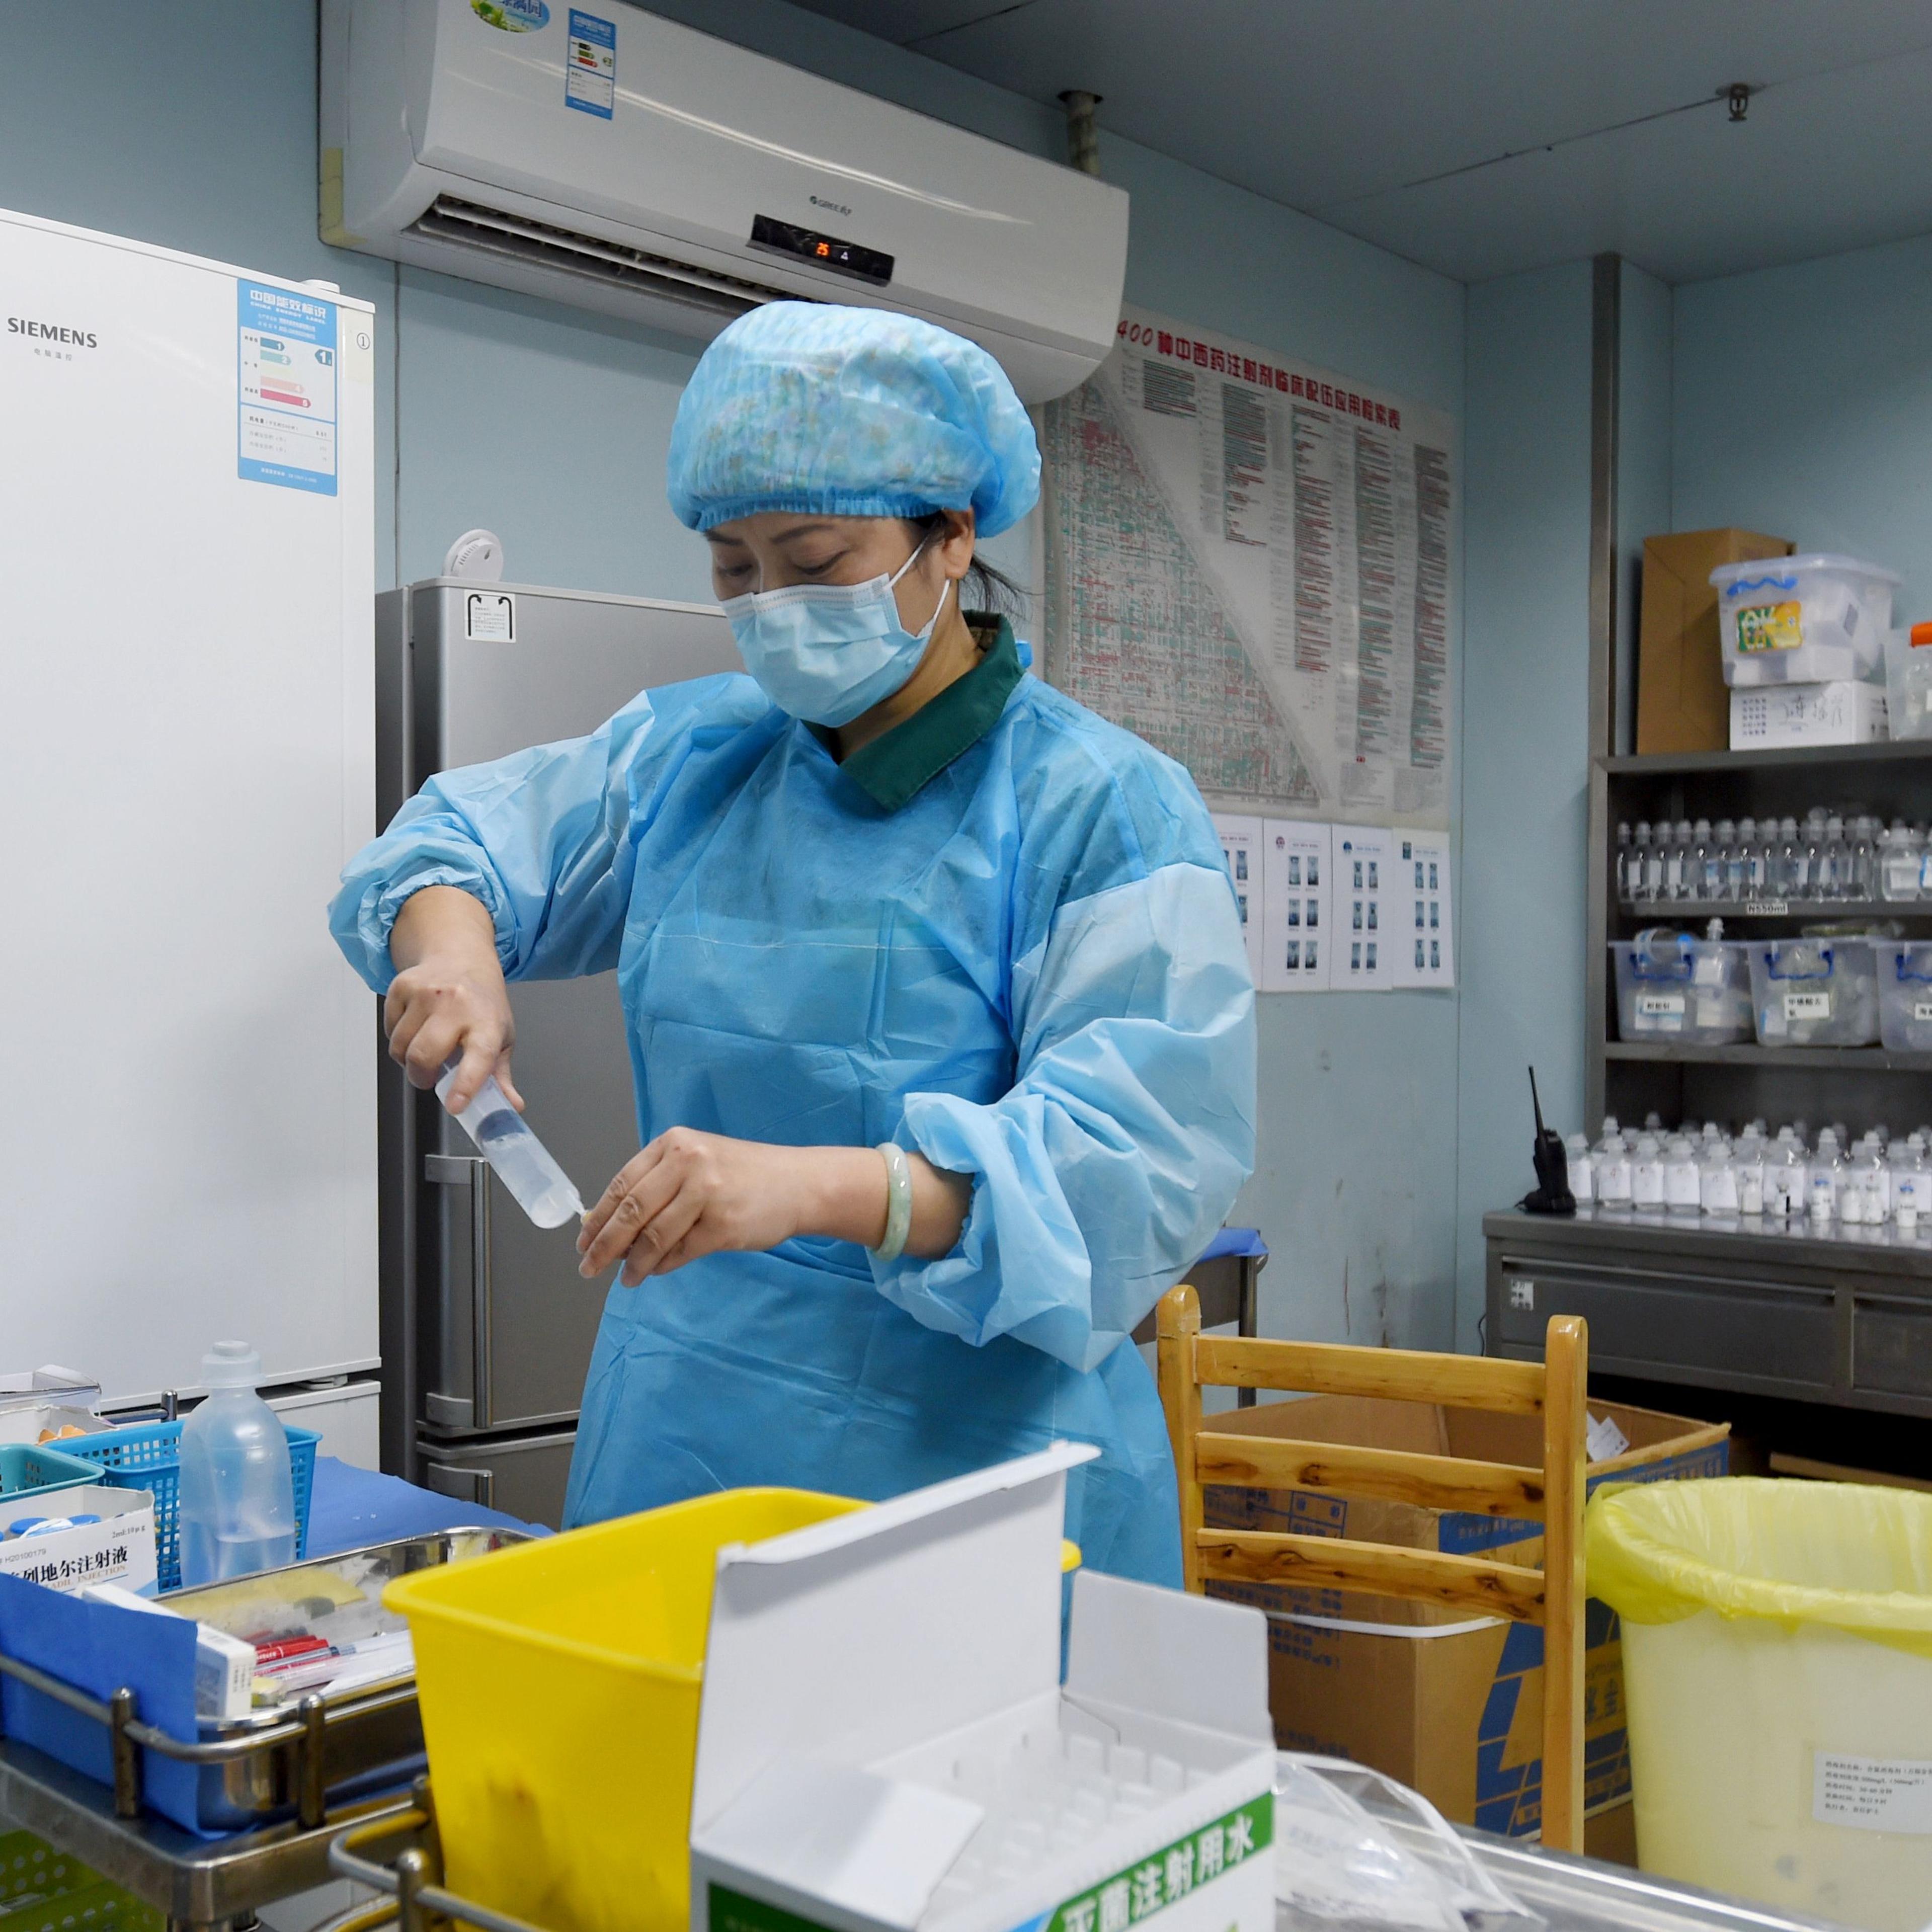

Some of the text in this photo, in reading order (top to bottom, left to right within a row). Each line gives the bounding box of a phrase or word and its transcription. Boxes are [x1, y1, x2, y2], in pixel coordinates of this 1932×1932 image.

[250, 289, 326, 318] 中国能效标识
[8, 317, 98, 349] SIEMENS
[11, 1545, 128, 1584] 列地尔注射液
[1063, 1812, 1255, 1932] 灭菌注射用水
